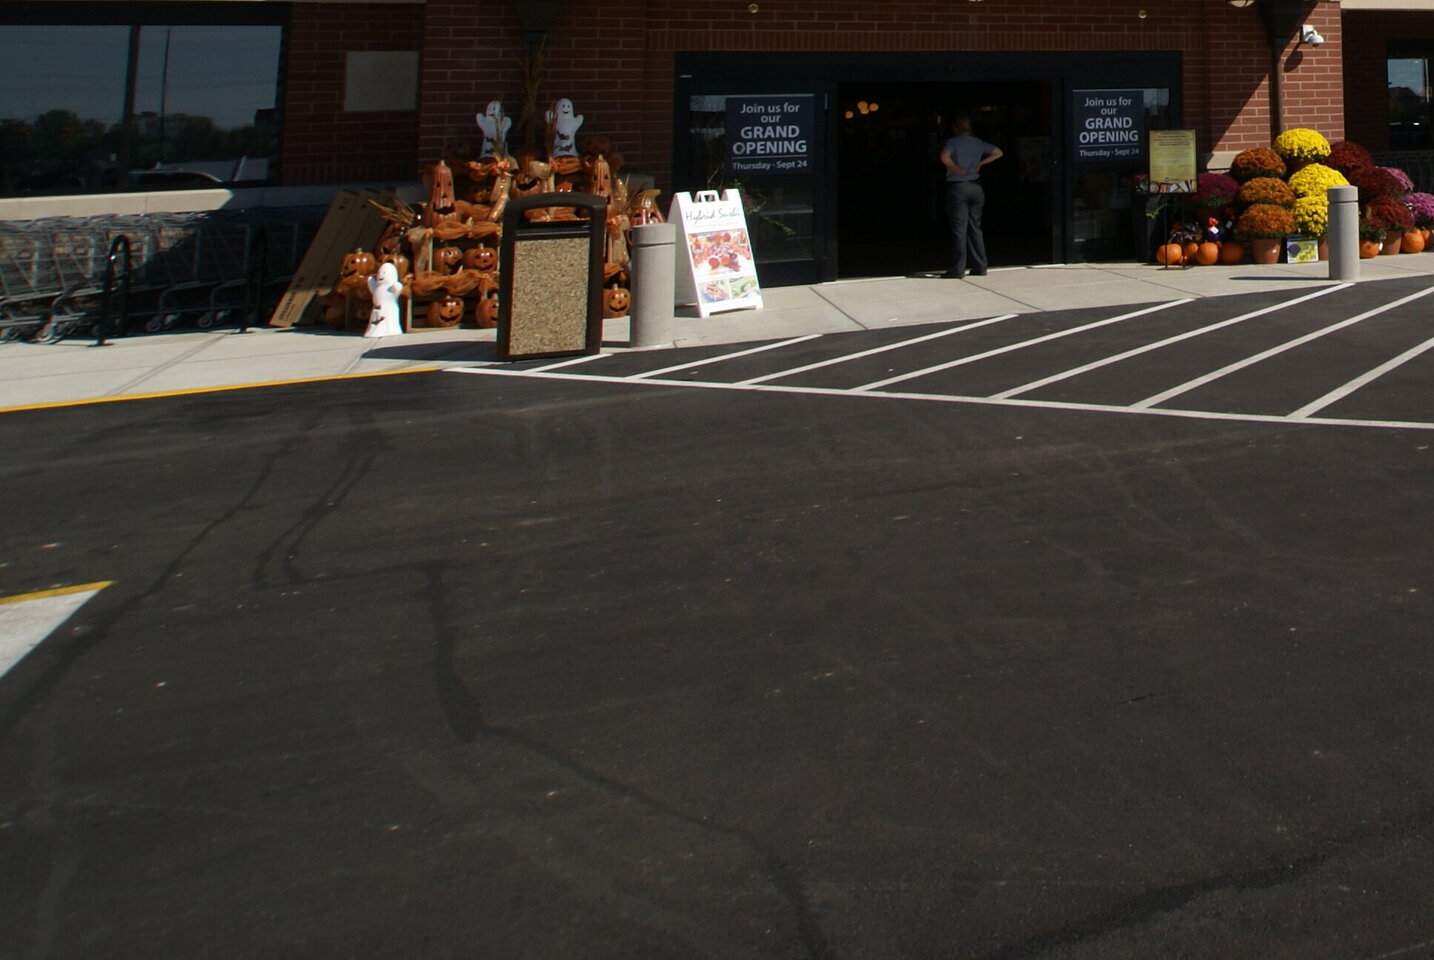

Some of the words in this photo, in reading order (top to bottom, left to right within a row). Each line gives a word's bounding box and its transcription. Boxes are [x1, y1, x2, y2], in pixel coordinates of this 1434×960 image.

[740, 103, 764, 114] Join
[767, 105, 781, 113] us
[783, 102, 800, 113] for
[1085, 97, 1104, 107] Join
[1119, 97, 1132, 106] for
[1101, 107, 1117, 115] our
[761, 115, 781, 123] our
[1085, 117, 1133, 130] GRAND
[741, 125, 800, 139] GRAND
[1079, 130, 1139, 143] OPENING
[732, 140, 807, 155] OPENING
[733, 161, 771, 171] Thursday
[776, 160, 795, 169] Sept
[797, 160, 808, 168] 24
[685, 208, 717, 225] Hybrid
